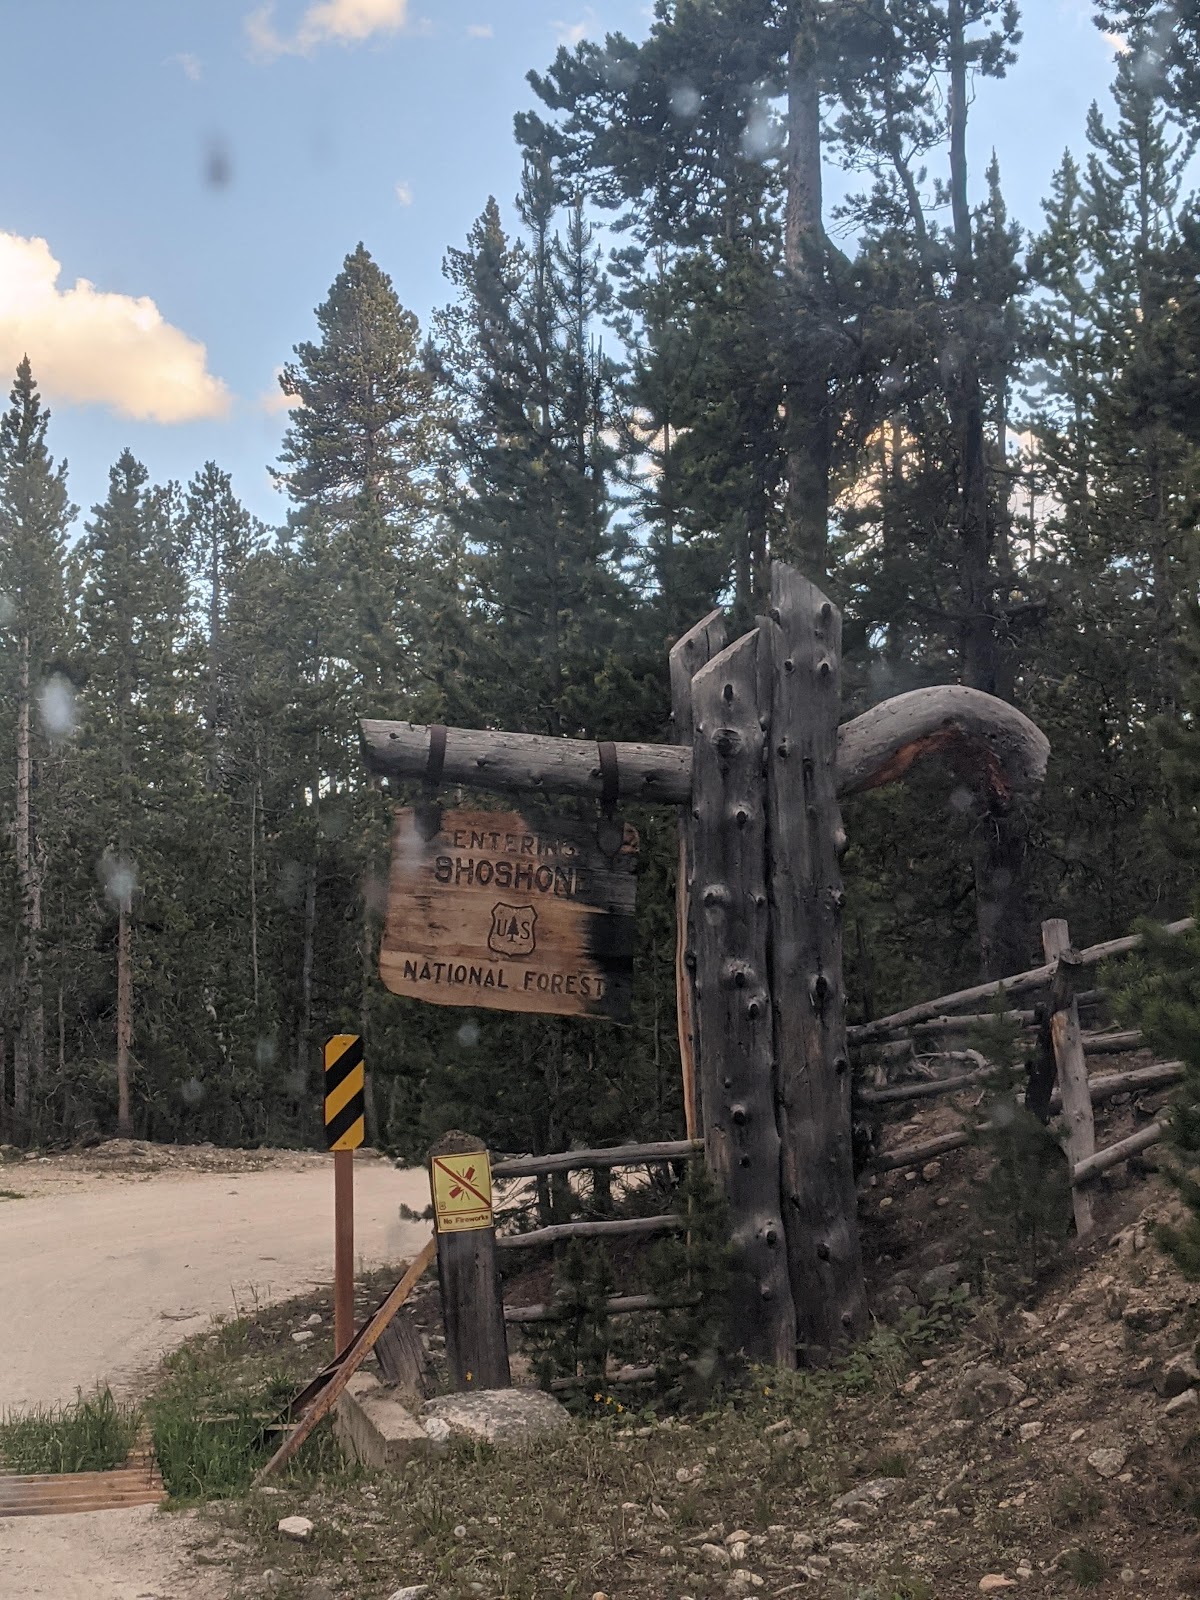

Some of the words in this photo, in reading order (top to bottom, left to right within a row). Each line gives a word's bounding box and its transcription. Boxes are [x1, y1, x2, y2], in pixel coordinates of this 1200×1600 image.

[403, 960, 509, 988] NATIONAL
[523, 971, 605, 998] FOREST
[455, 1214, 489, 1223] Fireworks
